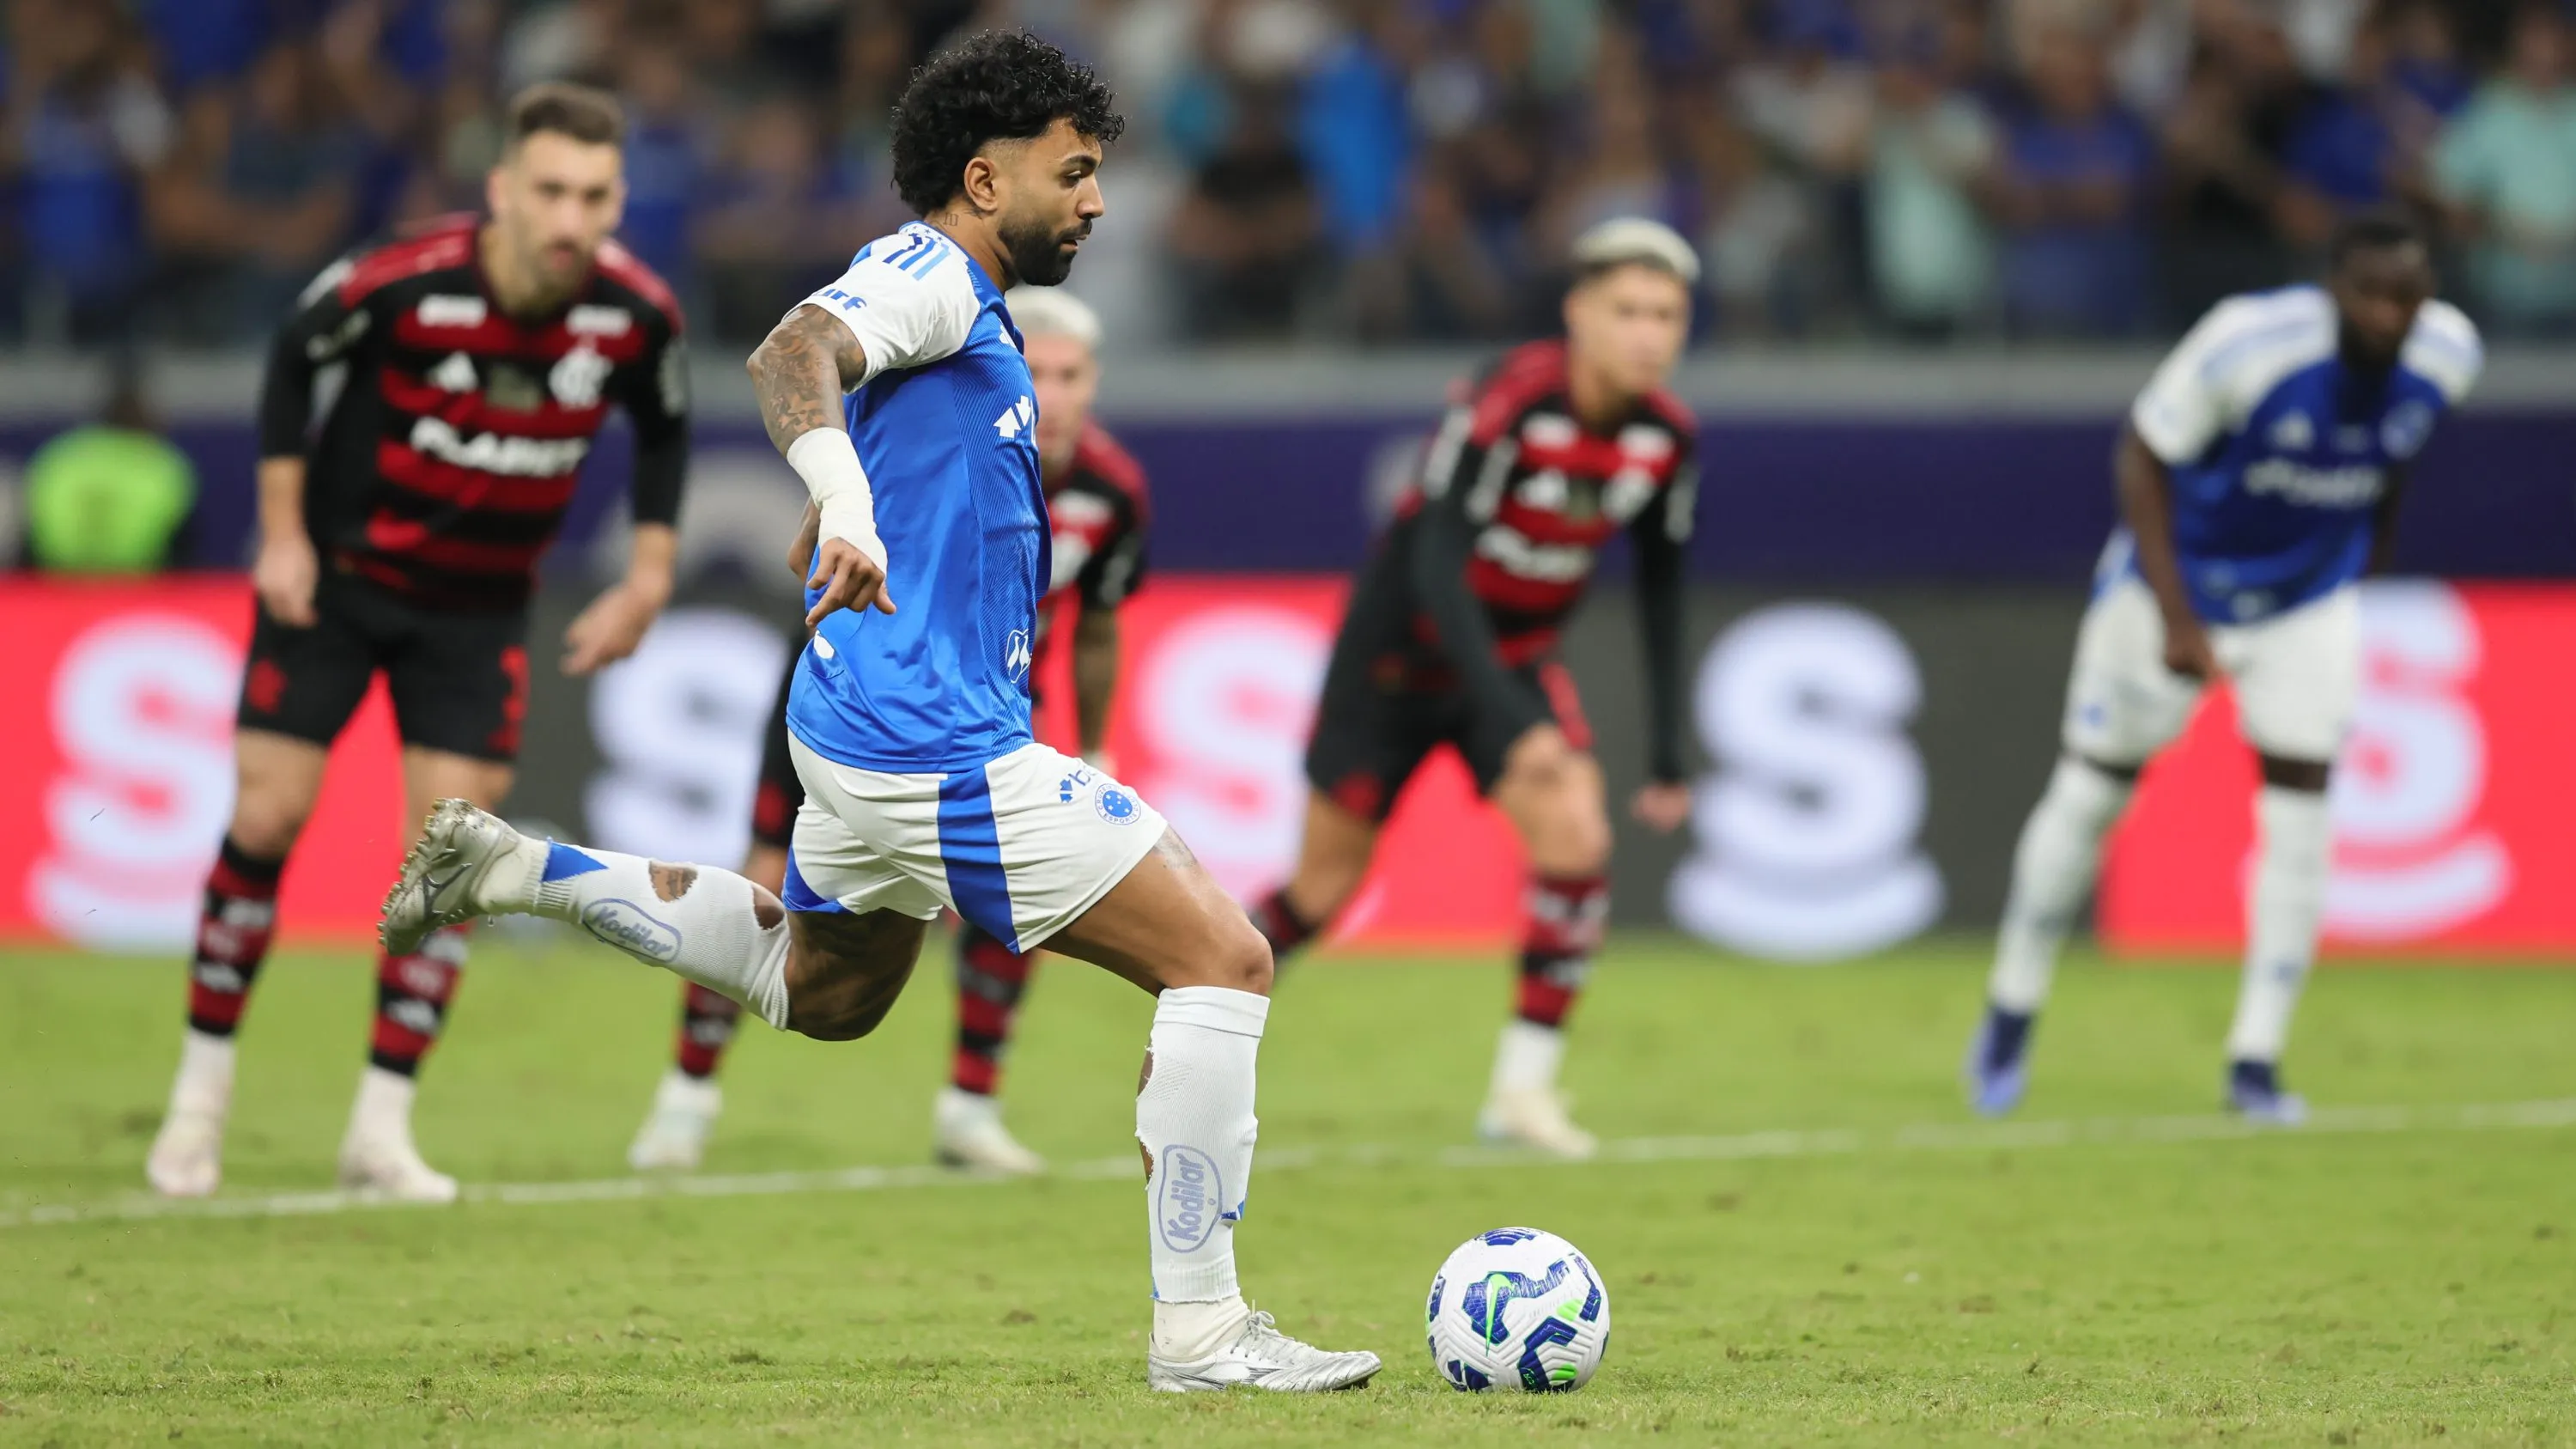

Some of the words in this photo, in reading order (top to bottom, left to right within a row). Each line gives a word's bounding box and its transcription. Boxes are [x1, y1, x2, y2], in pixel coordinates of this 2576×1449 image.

[1697, 605, 1927, 859] S
[593, 905, 673, 956] Kodilar
[1167, 1153, 1205, 1242] Kodilar
